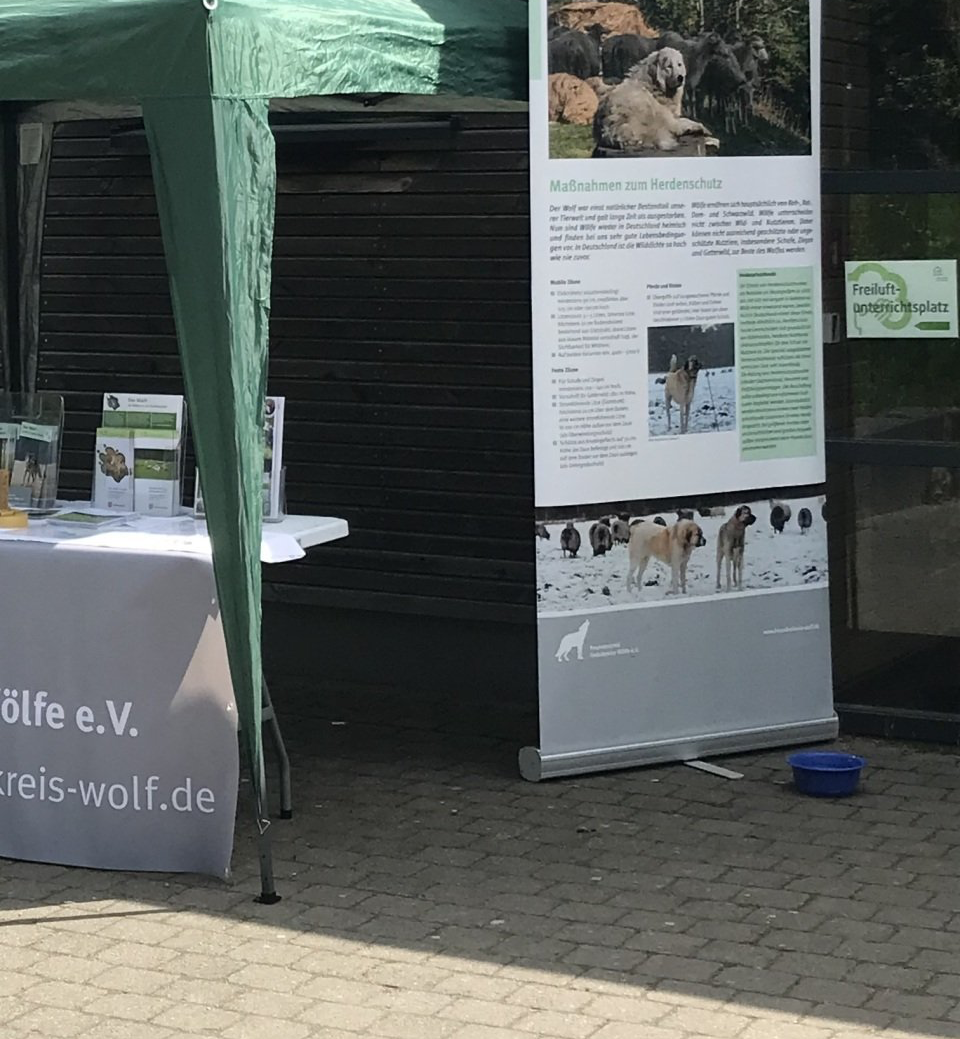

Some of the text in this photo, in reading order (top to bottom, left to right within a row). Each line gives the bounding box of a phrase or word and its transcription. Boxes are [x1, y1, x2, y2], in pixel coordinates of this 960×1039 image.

[550, 178, 722, 192] Maßnahmen zum Herdenschutz
[853, 283, 900, 295] Freiluft-
[853, 301, 949, 315] unterrichtsplatz
[76, 701, 138, 737] e.V.
